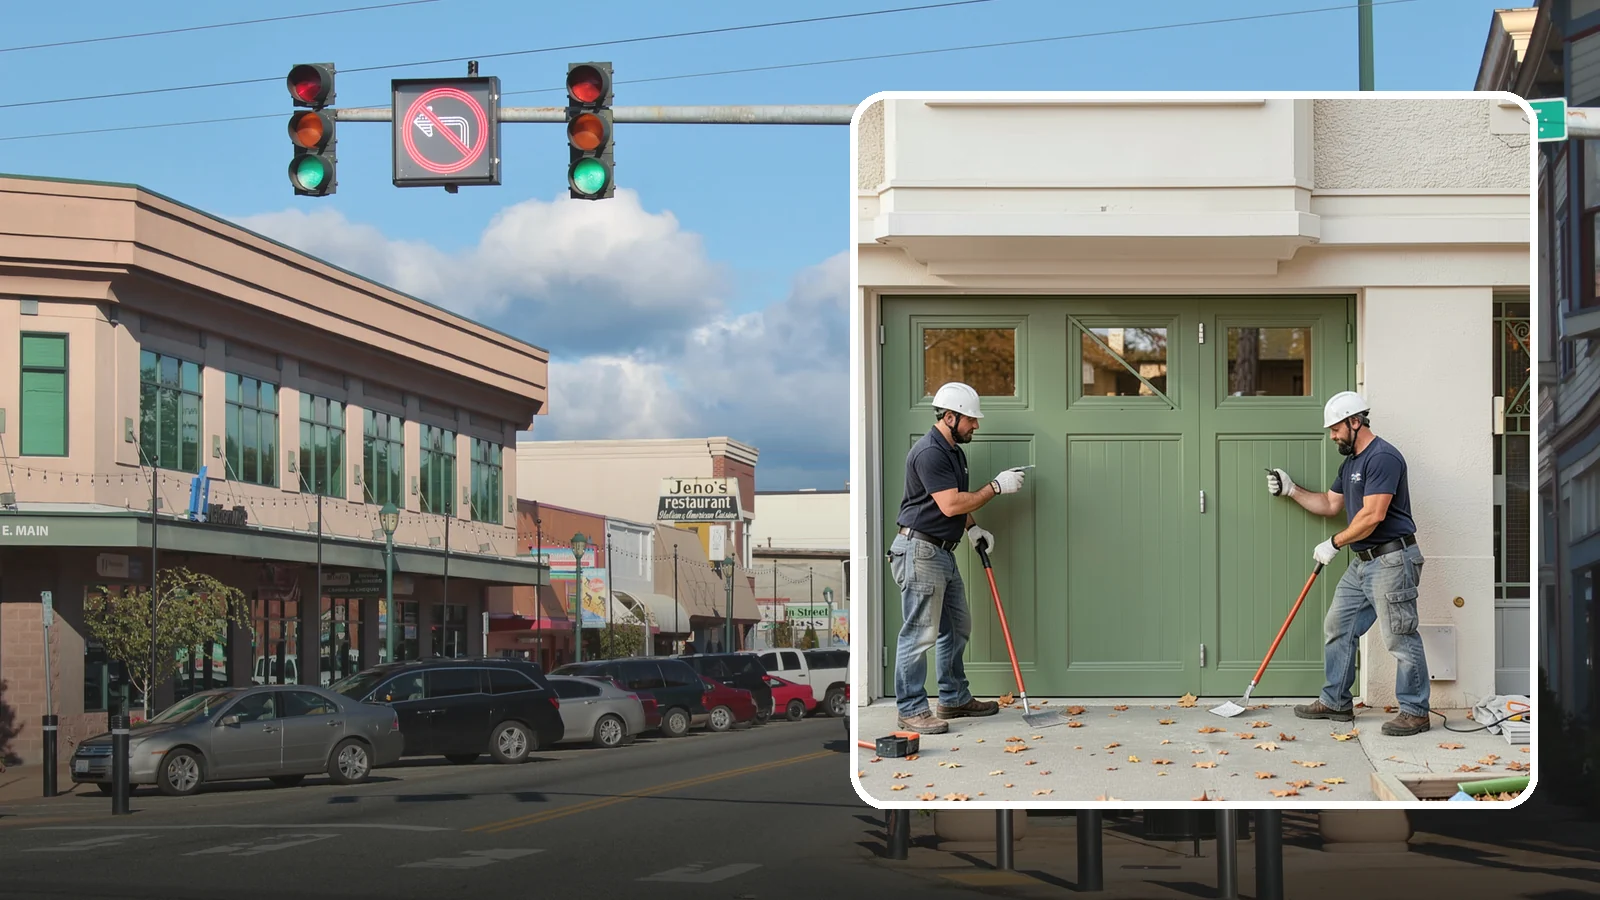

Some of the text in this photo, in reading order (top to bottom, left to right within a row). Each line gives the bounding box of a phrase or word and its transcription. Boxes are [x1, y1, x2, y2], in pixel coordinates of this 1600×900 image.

[670, 480, 727, 494] Jeno's
[665, 496, 731, 508] restaurant
[2, 525, 49, 536] E. MAIN
[797, 607, 828, 616] Street
